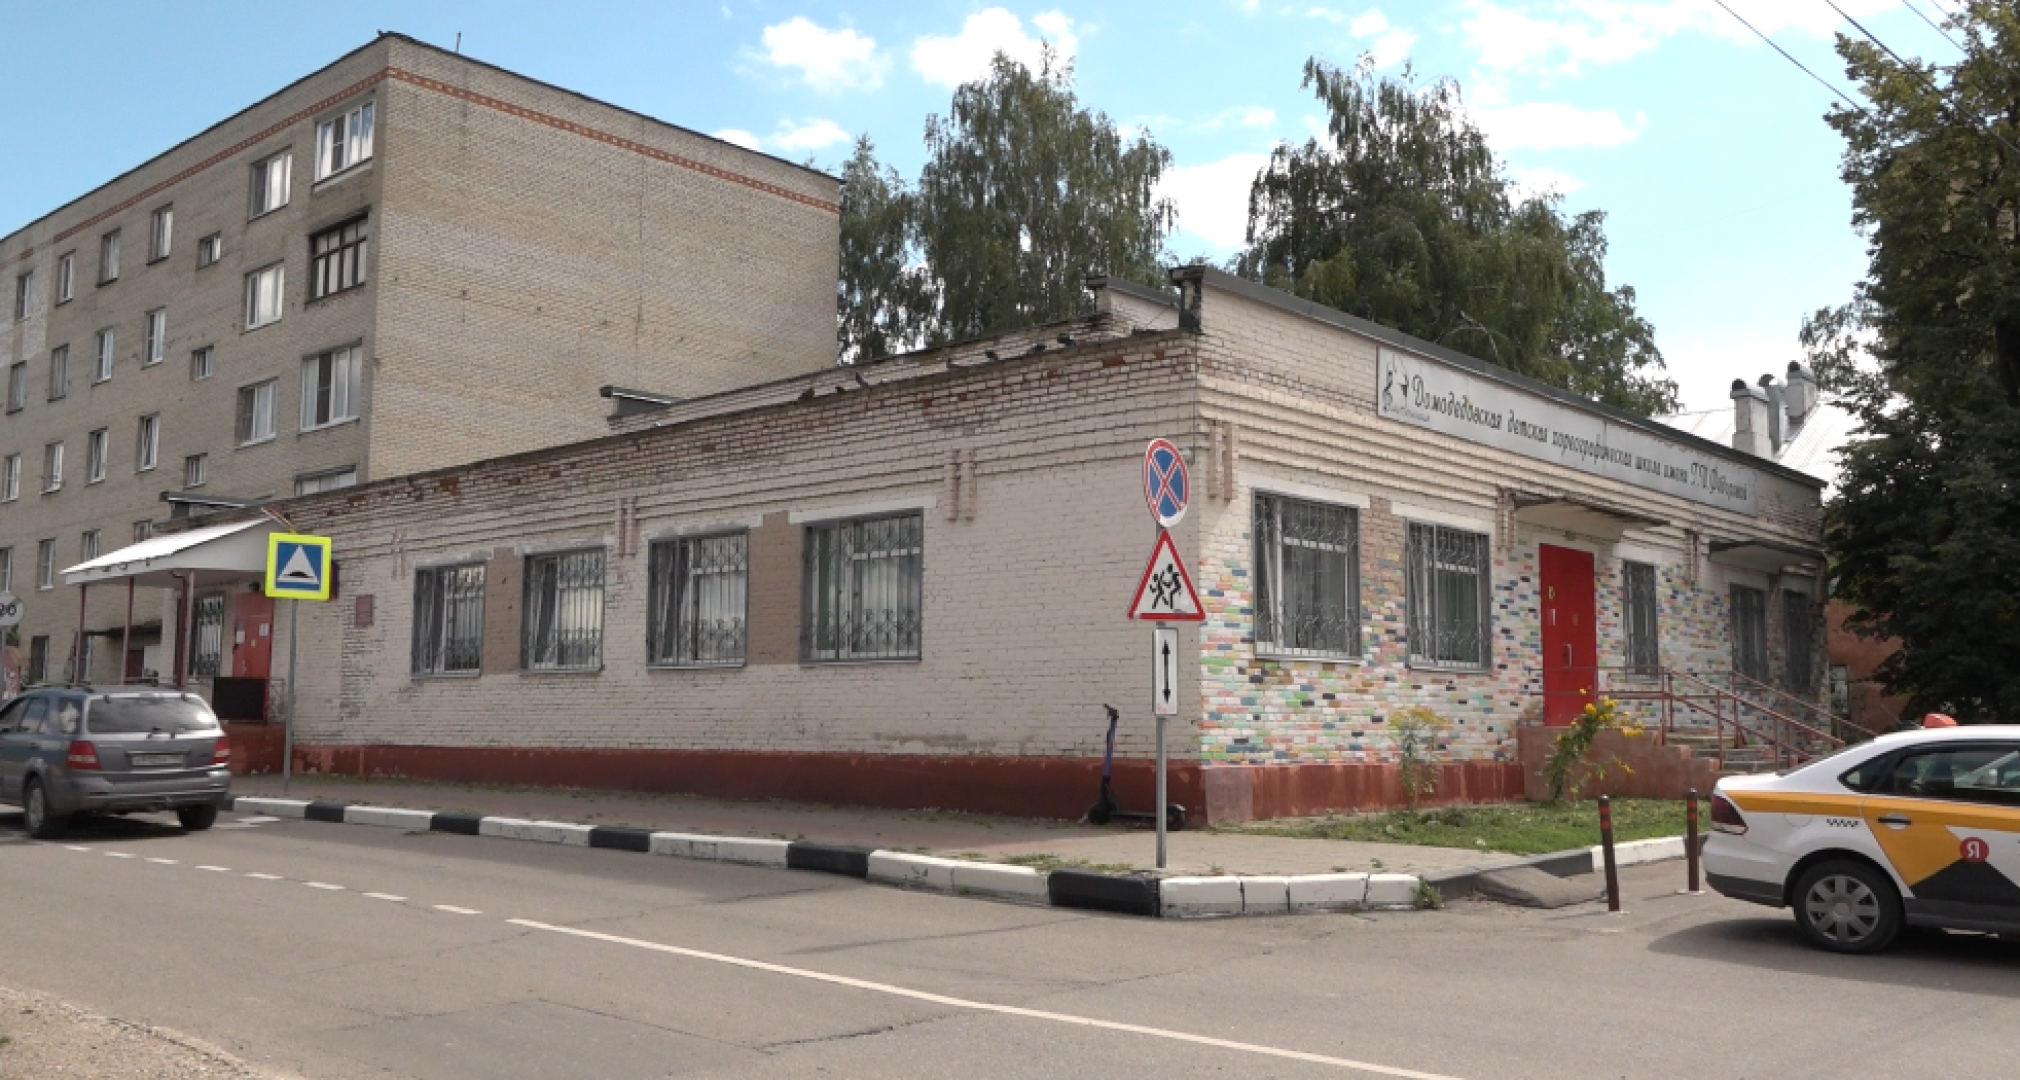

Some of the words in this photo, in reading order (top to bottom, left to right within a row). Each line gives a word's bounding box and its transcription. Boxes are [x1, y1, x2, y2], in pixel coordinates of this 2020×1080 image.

[1412, 373, 1502, 430] Домодедовская
[1508, 409, 1548, 443] детская
[1635, 456, 1660, 476] школа
[1967, 840, 1980, 859] Я
